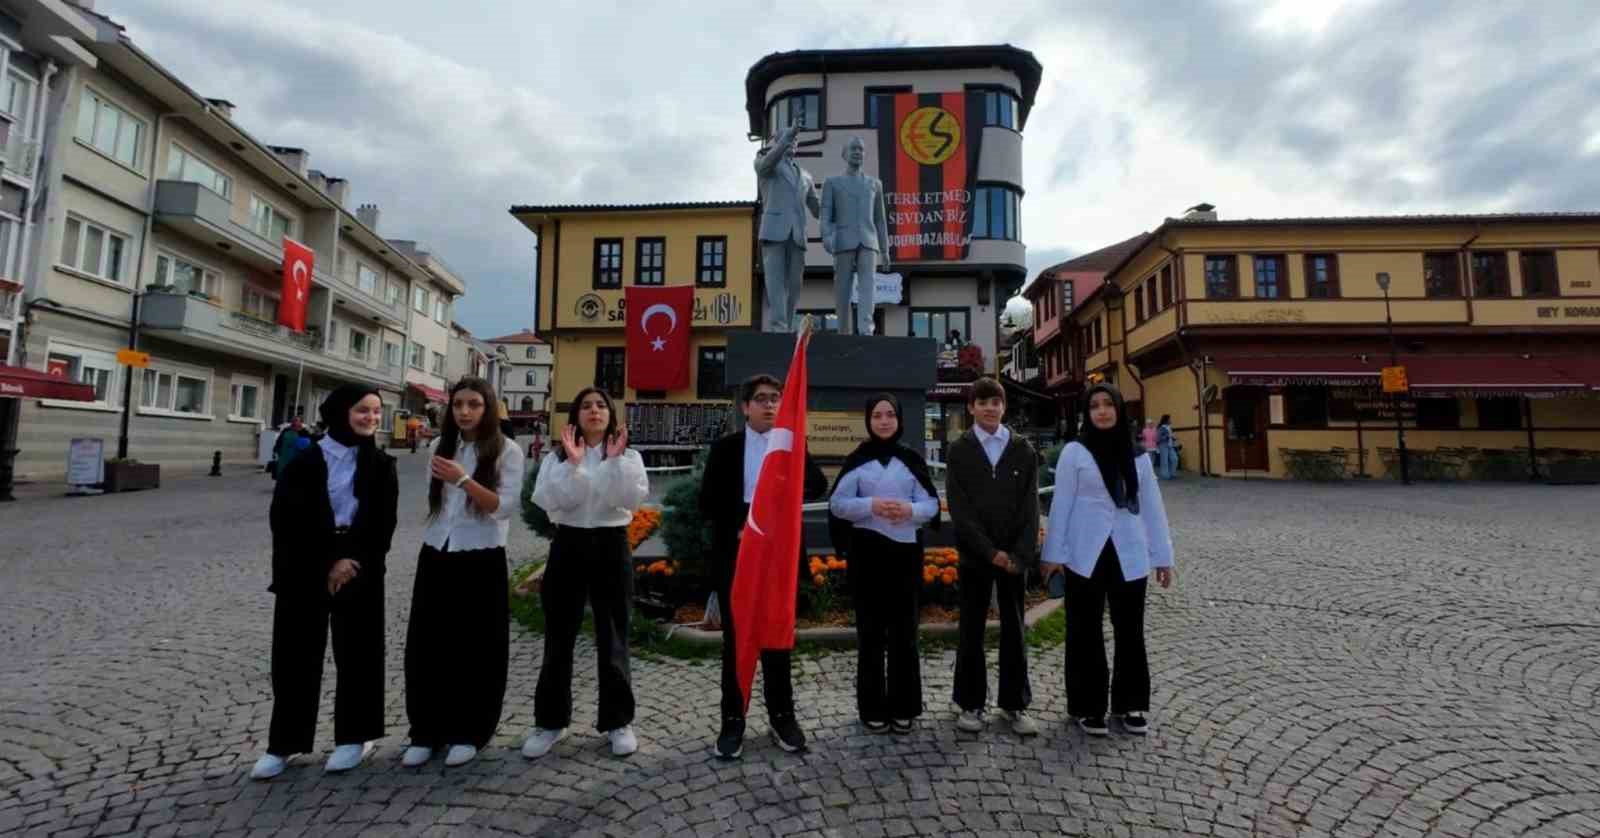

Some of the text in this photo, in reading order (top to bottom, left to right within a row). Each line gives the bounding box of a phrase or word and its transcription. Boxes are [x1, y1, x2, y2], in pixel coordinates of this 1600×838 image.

[886, 189, 972, 205] TERK ETMED
[888, 210, 944, 225] SEVDAN
